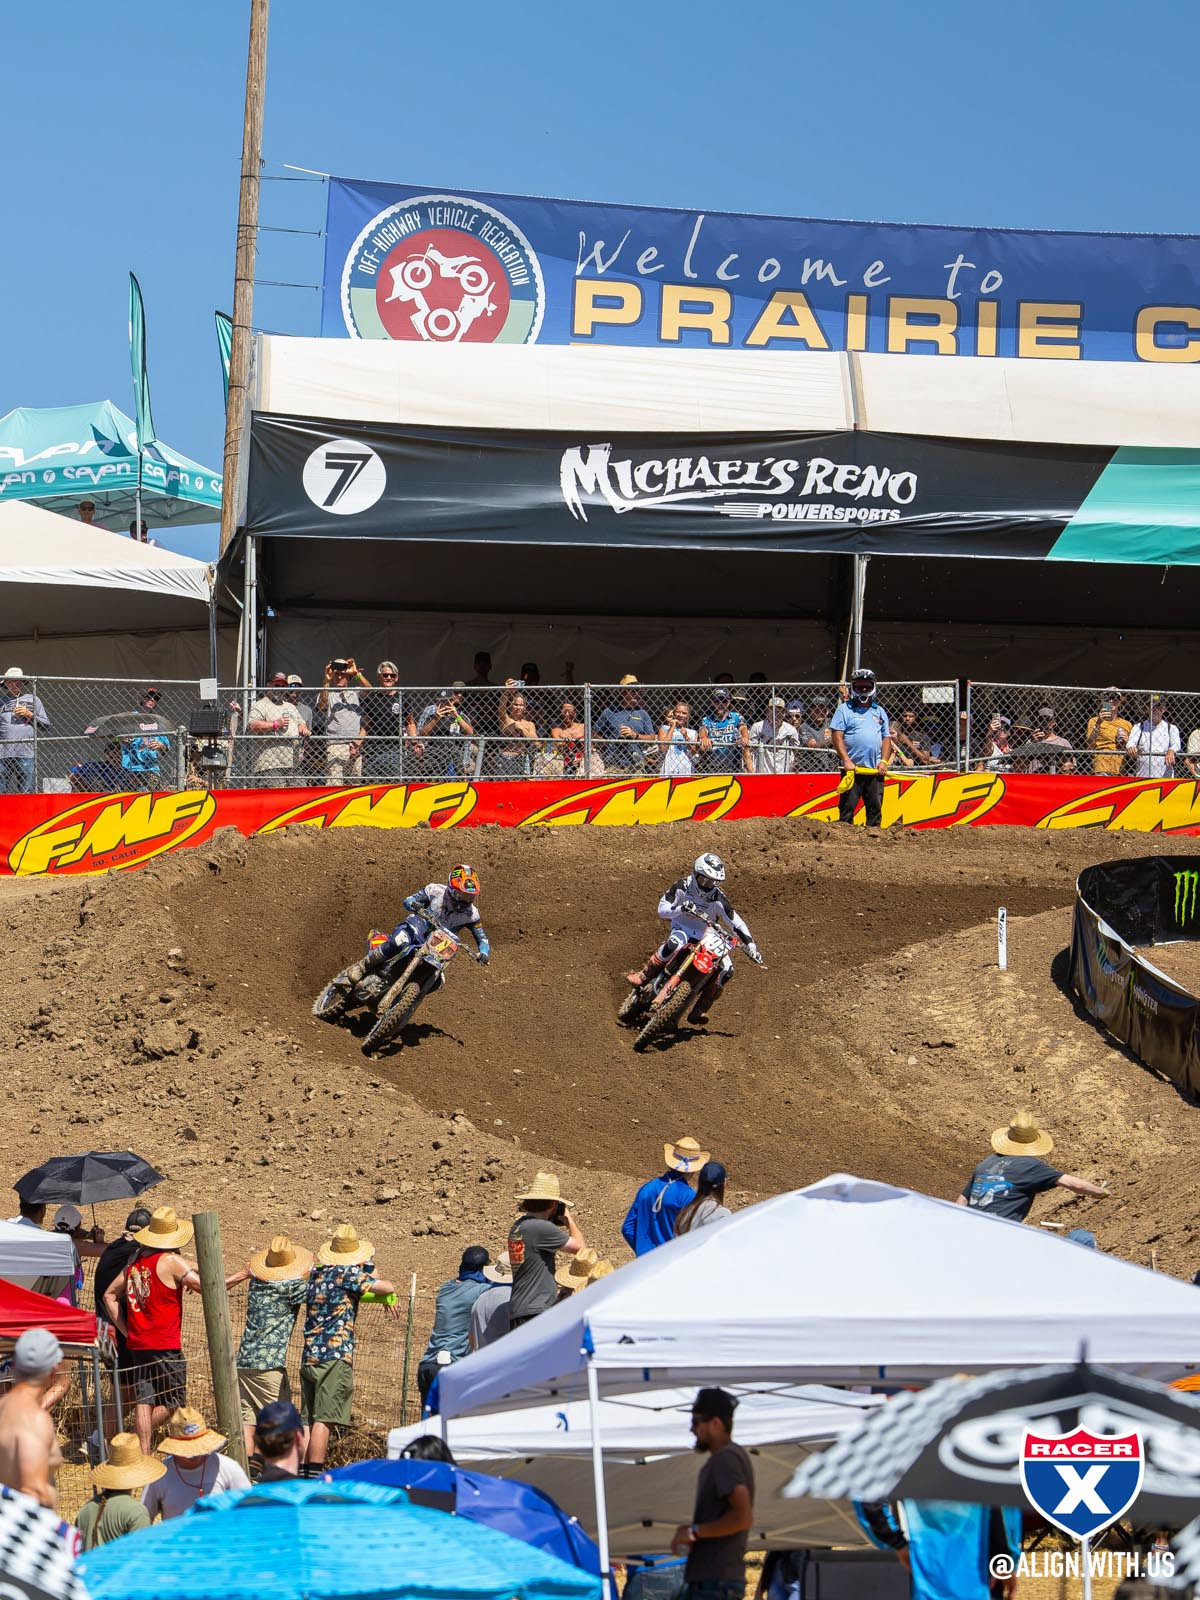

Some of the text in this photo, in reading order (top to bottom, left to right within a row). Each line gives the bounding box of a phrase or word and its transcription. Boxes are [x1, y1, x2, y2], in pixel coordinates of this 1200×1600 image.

[357, 206, 530, 287] OFF-HIGHWAY VEHICLE RECREATION
[575, 215, 1004, 300] Welcome to
[572, 277, 1082, 360] PRAIRIE
[16, 789, 210, 875] FMF
